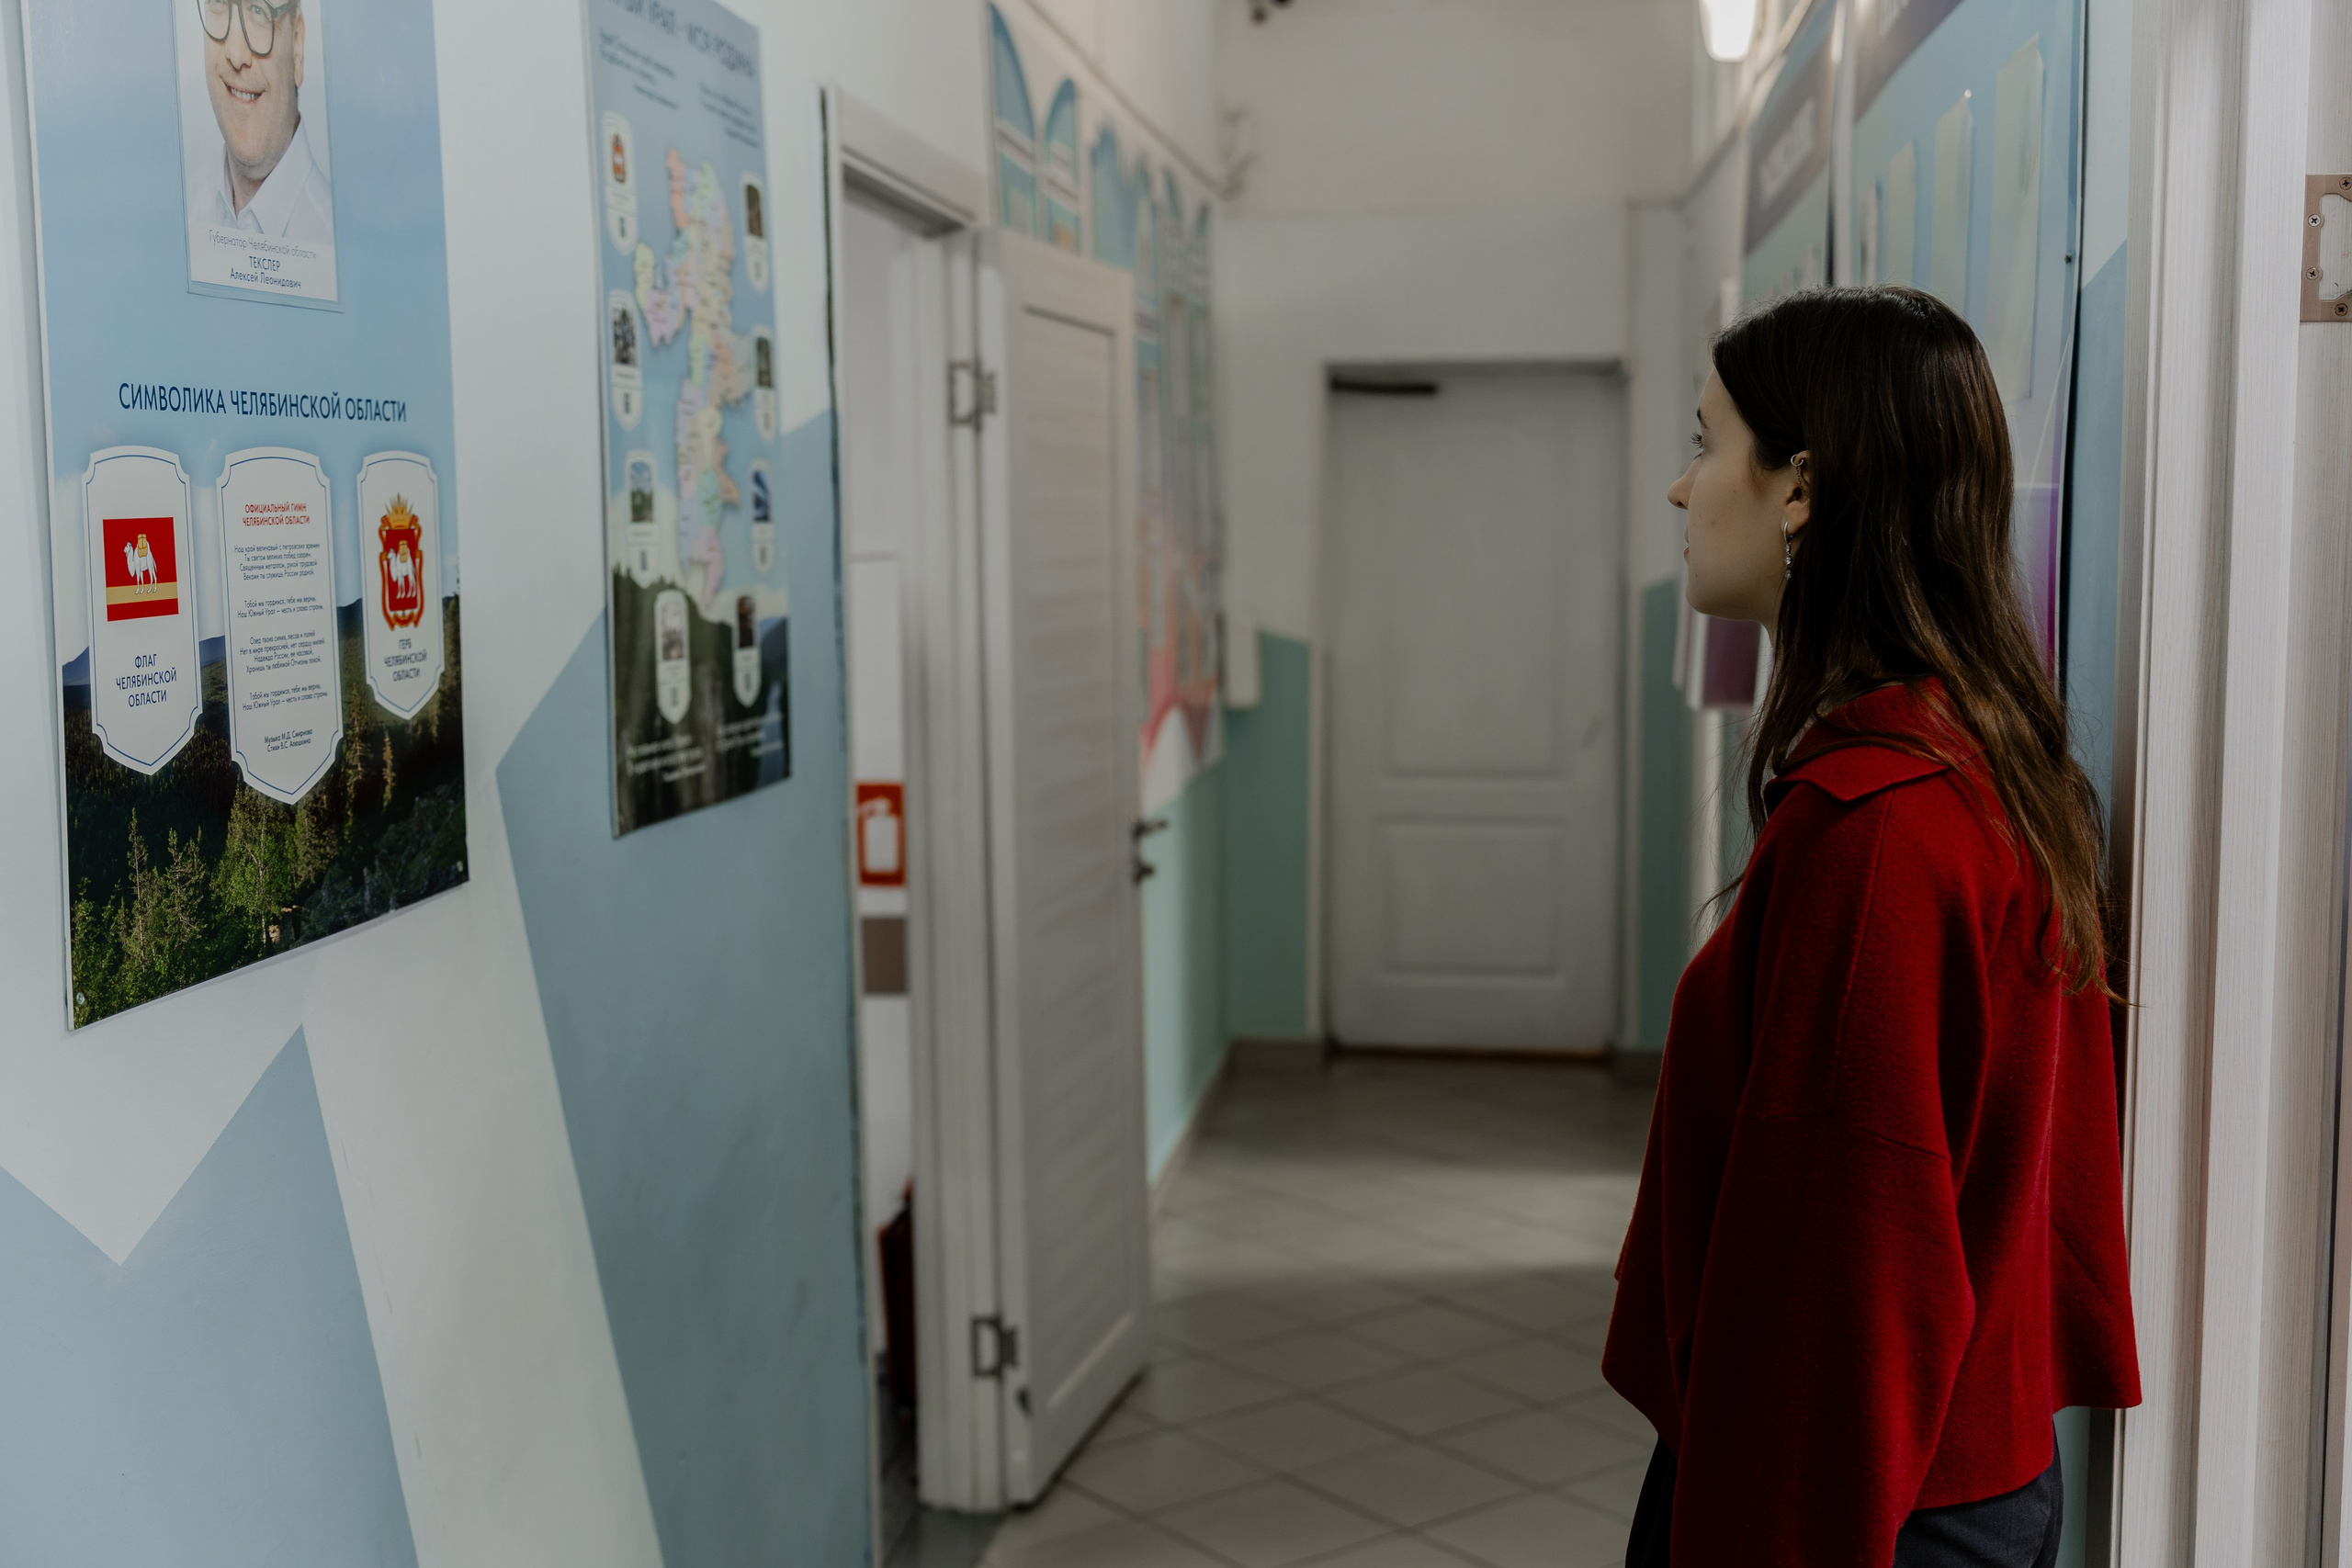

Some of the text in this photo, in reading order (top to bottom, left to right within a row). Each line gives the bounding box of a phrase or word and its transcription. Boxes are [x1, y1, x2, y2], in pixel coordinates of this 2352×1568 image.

[209, 230, 317, 259] Губернатор Челябинской области
[249, 255, 281, 272] ТЕКСЛЕР
[230, 267, 301, 288] Алексей Леонидович
[119, 382, 407, 422] СИМВОЛИКА ЧЕЛЯБИНСКОЙ ОБЛАСТИ
[244, 502, 307, 514] ОФИЦИАЛЬНЫЙ ГИМН
[243, 514, 311, 526] ЧЕЛЯБИНСКОЙ ОБЛАСТИ
[134, 653, 157, 669] ФЛАГ
[383, 649, 428, 668] ЧЕЛЯБИНСКОЙ
[116, 666, 177, 690] ЧЕЛЯБИНСКОЙ
[392, 668, 421, 682] ОБЛАСТИ
[128, 690, 167, 707] ОБЛАСТИ
